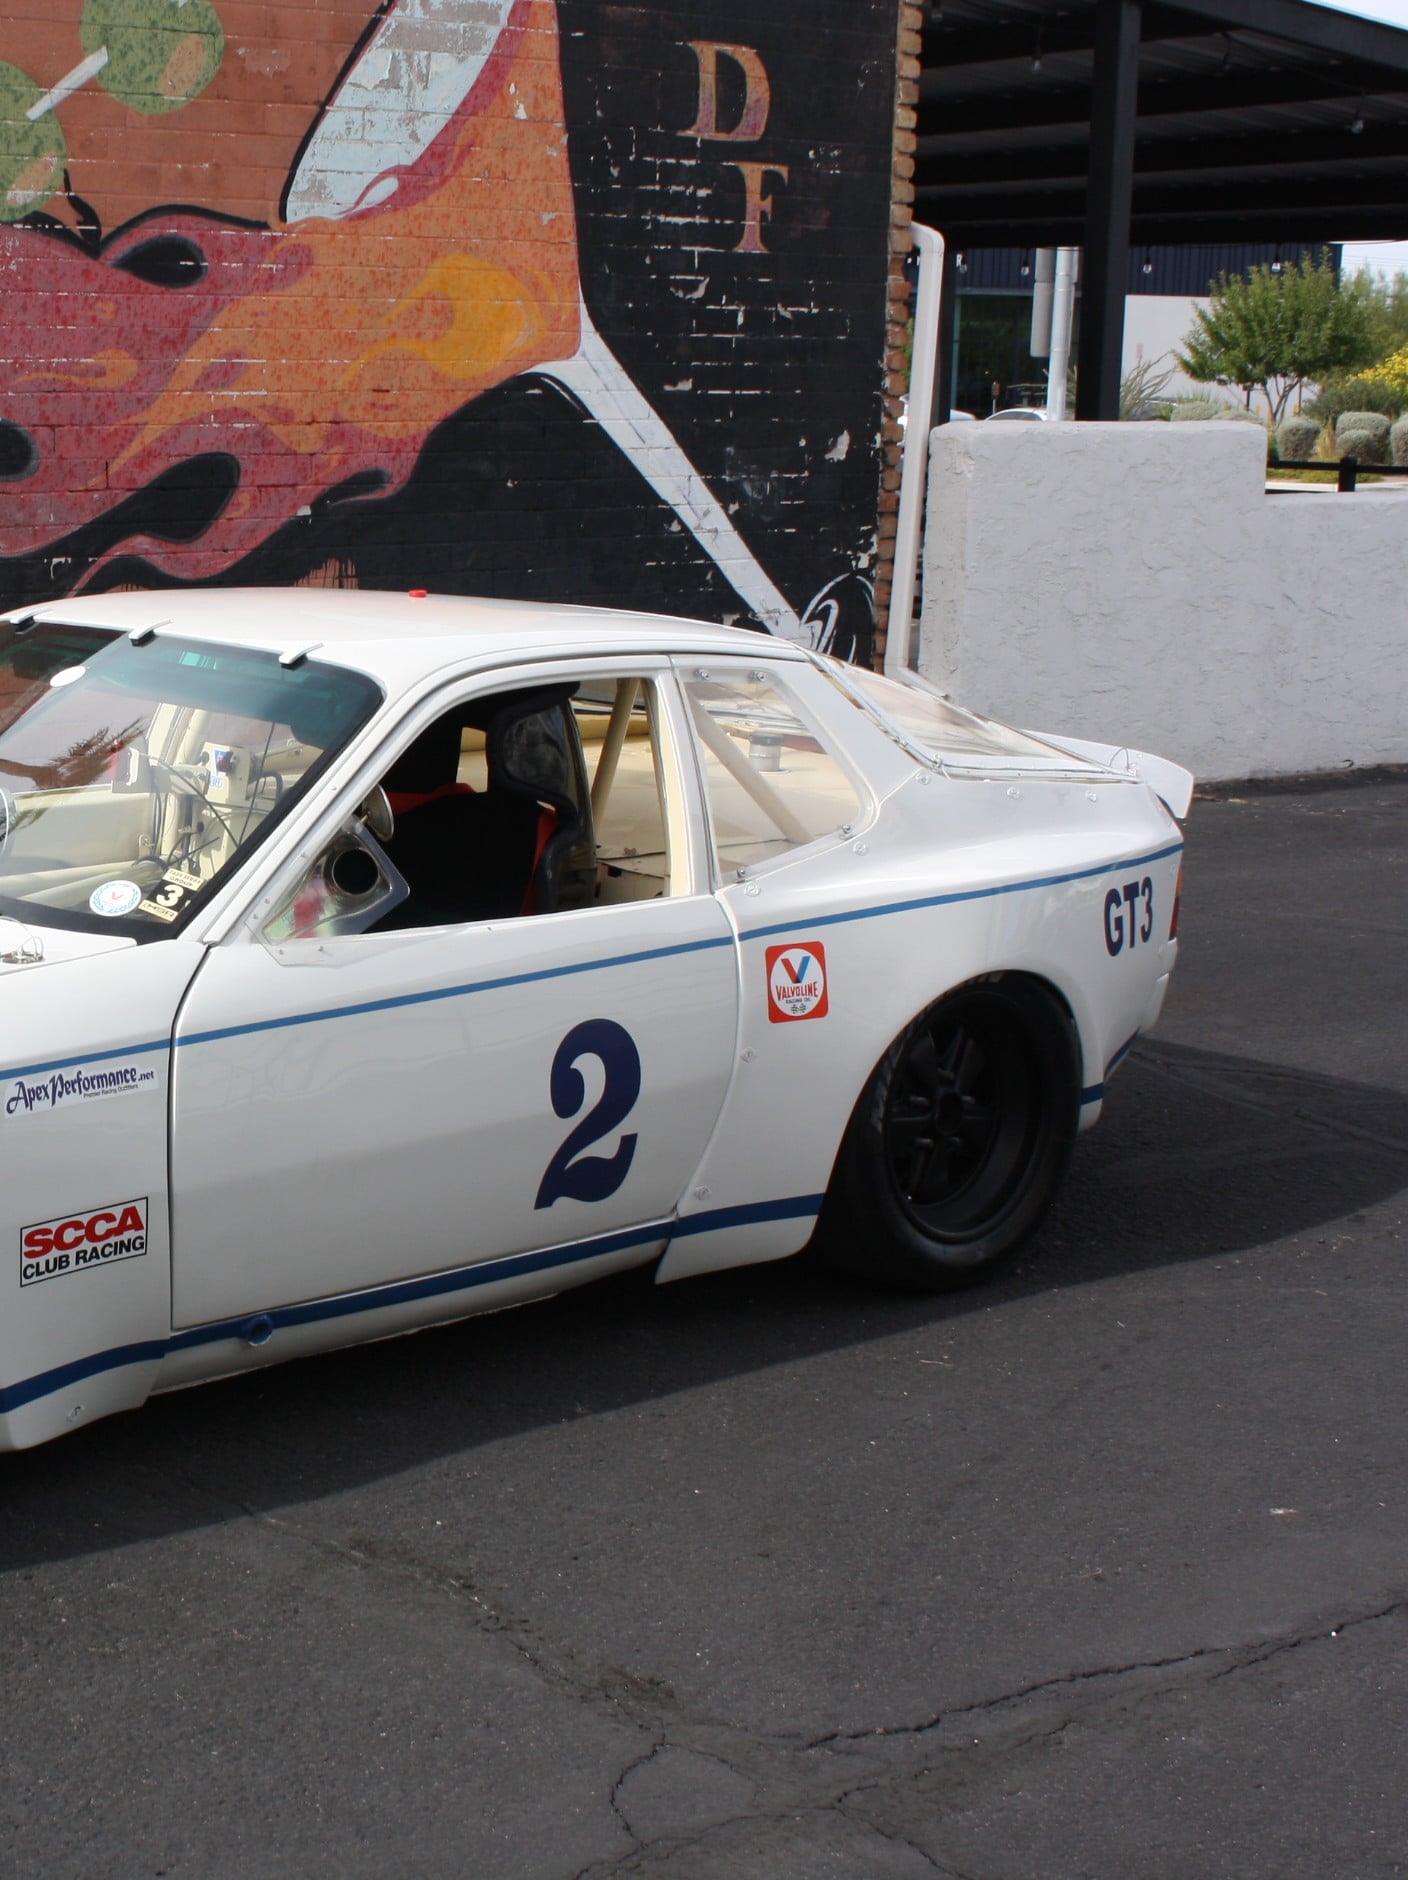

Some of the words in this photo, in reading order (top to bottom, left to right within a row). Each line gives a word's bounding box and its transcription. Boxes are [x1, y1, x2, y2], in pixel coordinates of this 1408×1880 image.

[676, 40, 771, 142] D
[722, 161, 789, 253] F
[156, 884, 184, 907] 3
[1104, 876, 1153, 957] GT3
[775, 981, 819, 1001] VALVOLINE
[534, 1018, 641, 1210] 2
[22, 1253, 71, 1280] CLUB
[75, 1235, 145, 1266] RACING
[24, 1205, 145, 1259] SCCA
